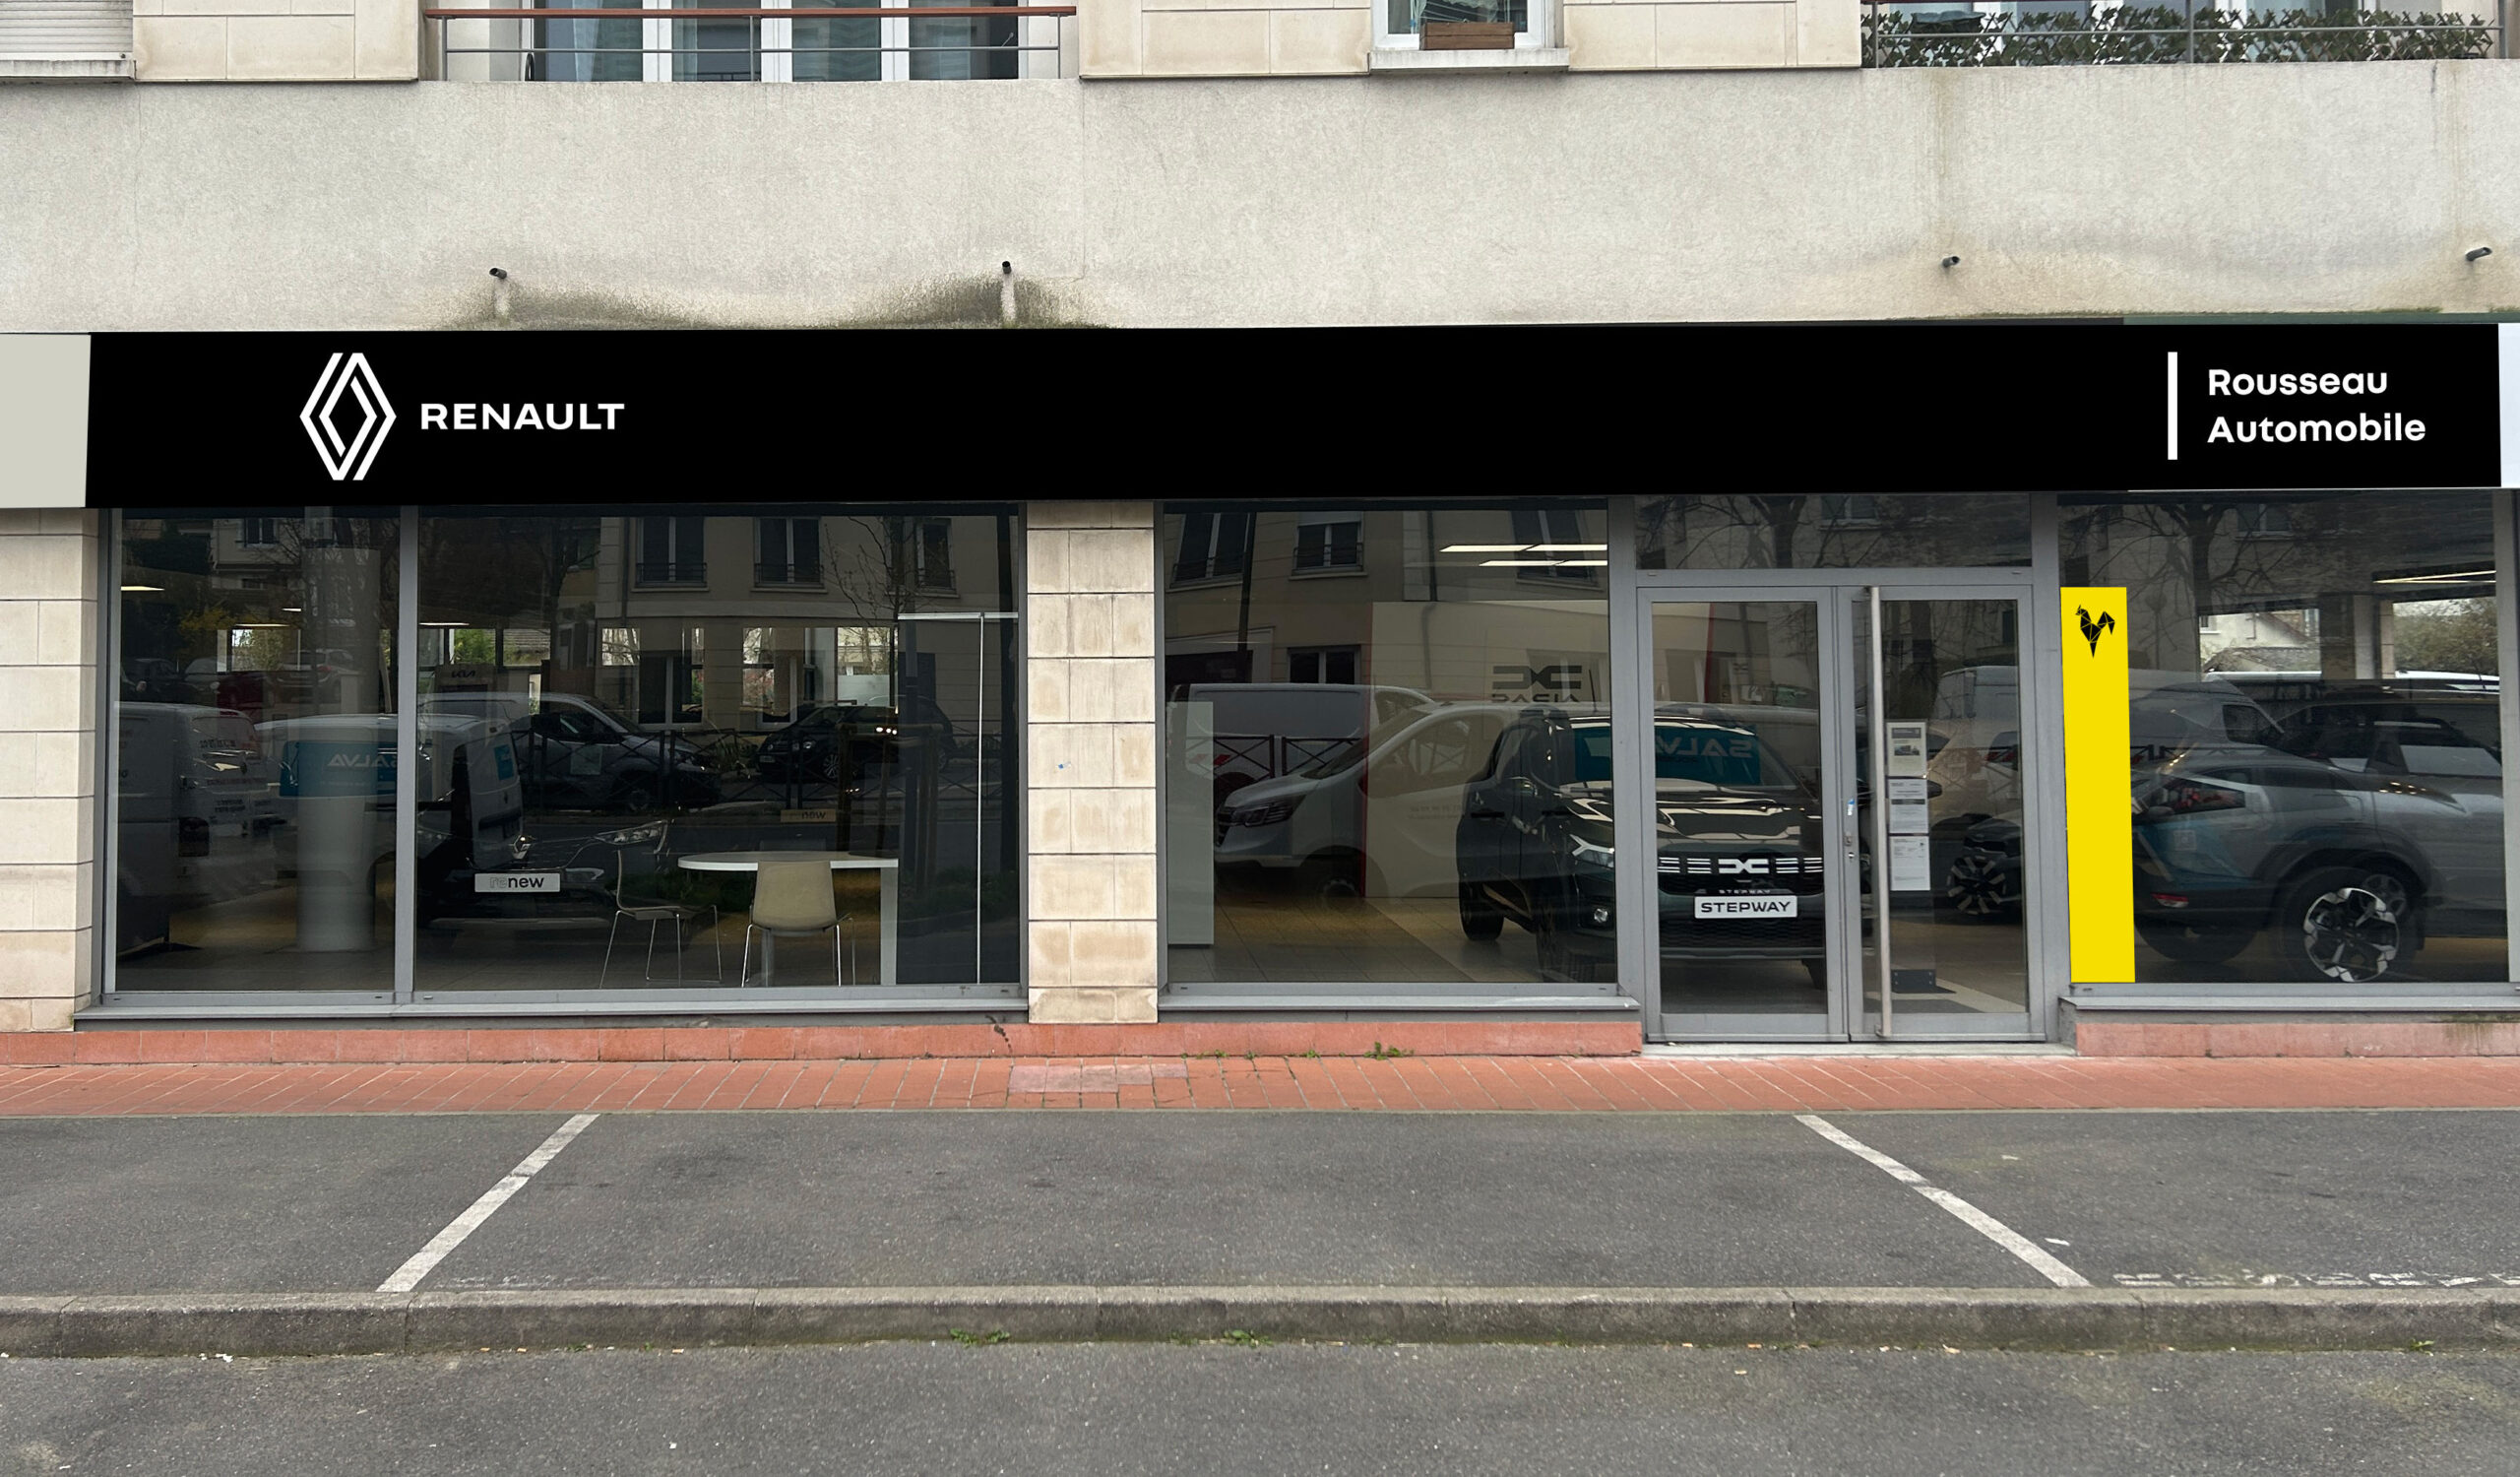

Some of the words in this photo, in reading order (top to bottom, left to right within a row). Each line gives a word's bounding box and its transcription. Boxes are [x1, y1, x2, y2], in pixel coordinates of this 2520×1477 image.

[2208, 368, 2388, 396] Rousseau
[420, 403, 625, 430] RENAULT
[2207, 412, 2426, 443] Automobile
[1491, 693, 1580, 703] DACIA
[489, 876, 545, 889] renew
[1701, 901, 1792, 913] STEPWAY
